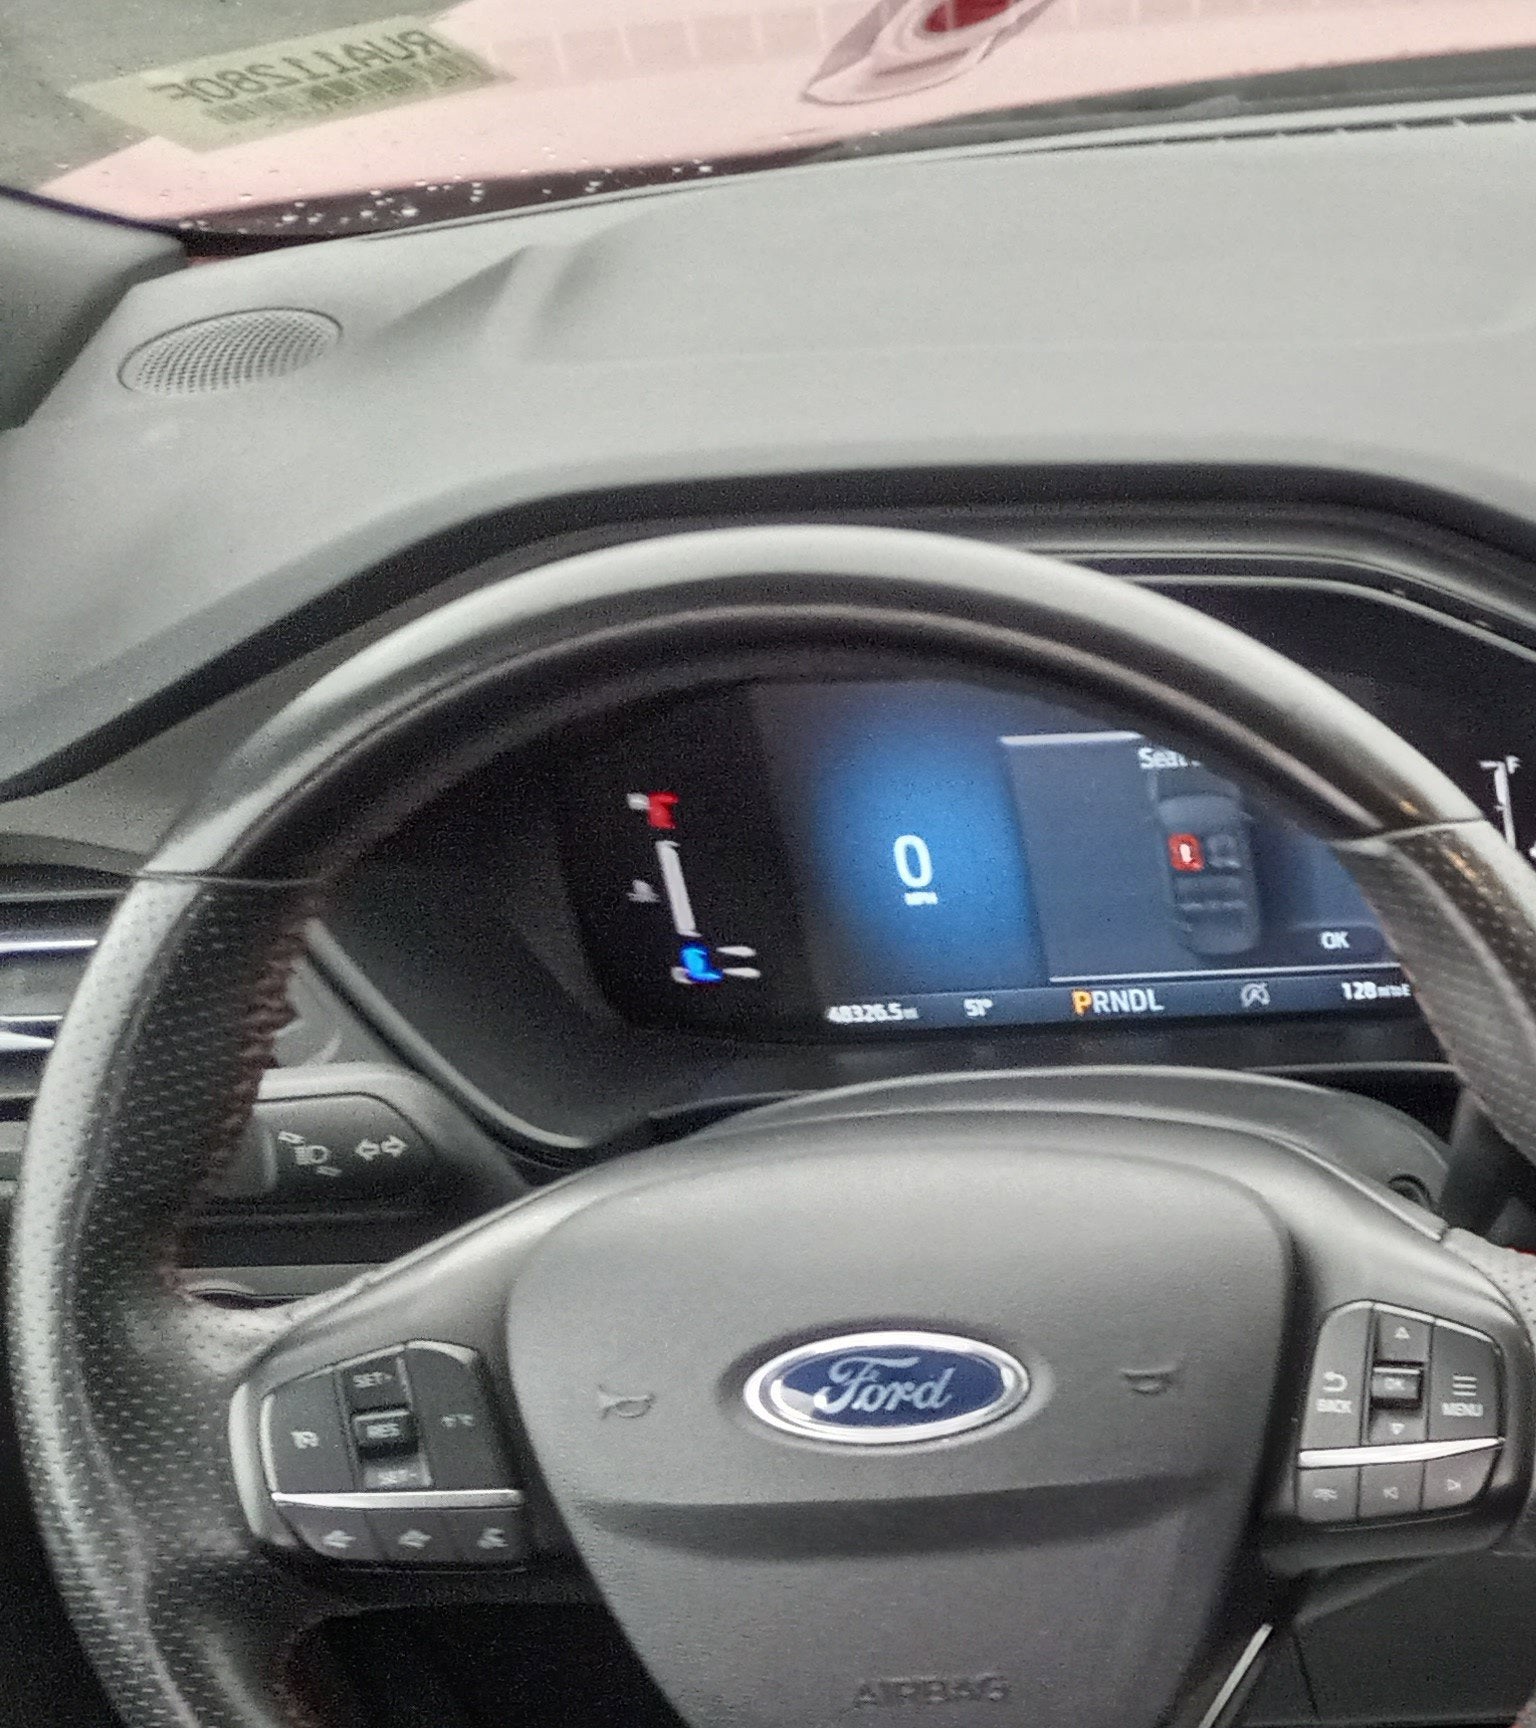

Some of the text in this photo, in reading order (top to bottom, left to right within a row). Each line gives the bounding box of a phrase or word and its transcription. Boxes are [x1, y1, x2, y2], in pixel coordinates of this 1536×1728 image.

[893, 834, 933, 888] 0
[1320, 931, 1350, 949] OK
[1072, 987, 1165, 1016] PRNDL
[813, 1356, 955, 1414] Ford
[1442, 1402, 1484, 1417] MENU
